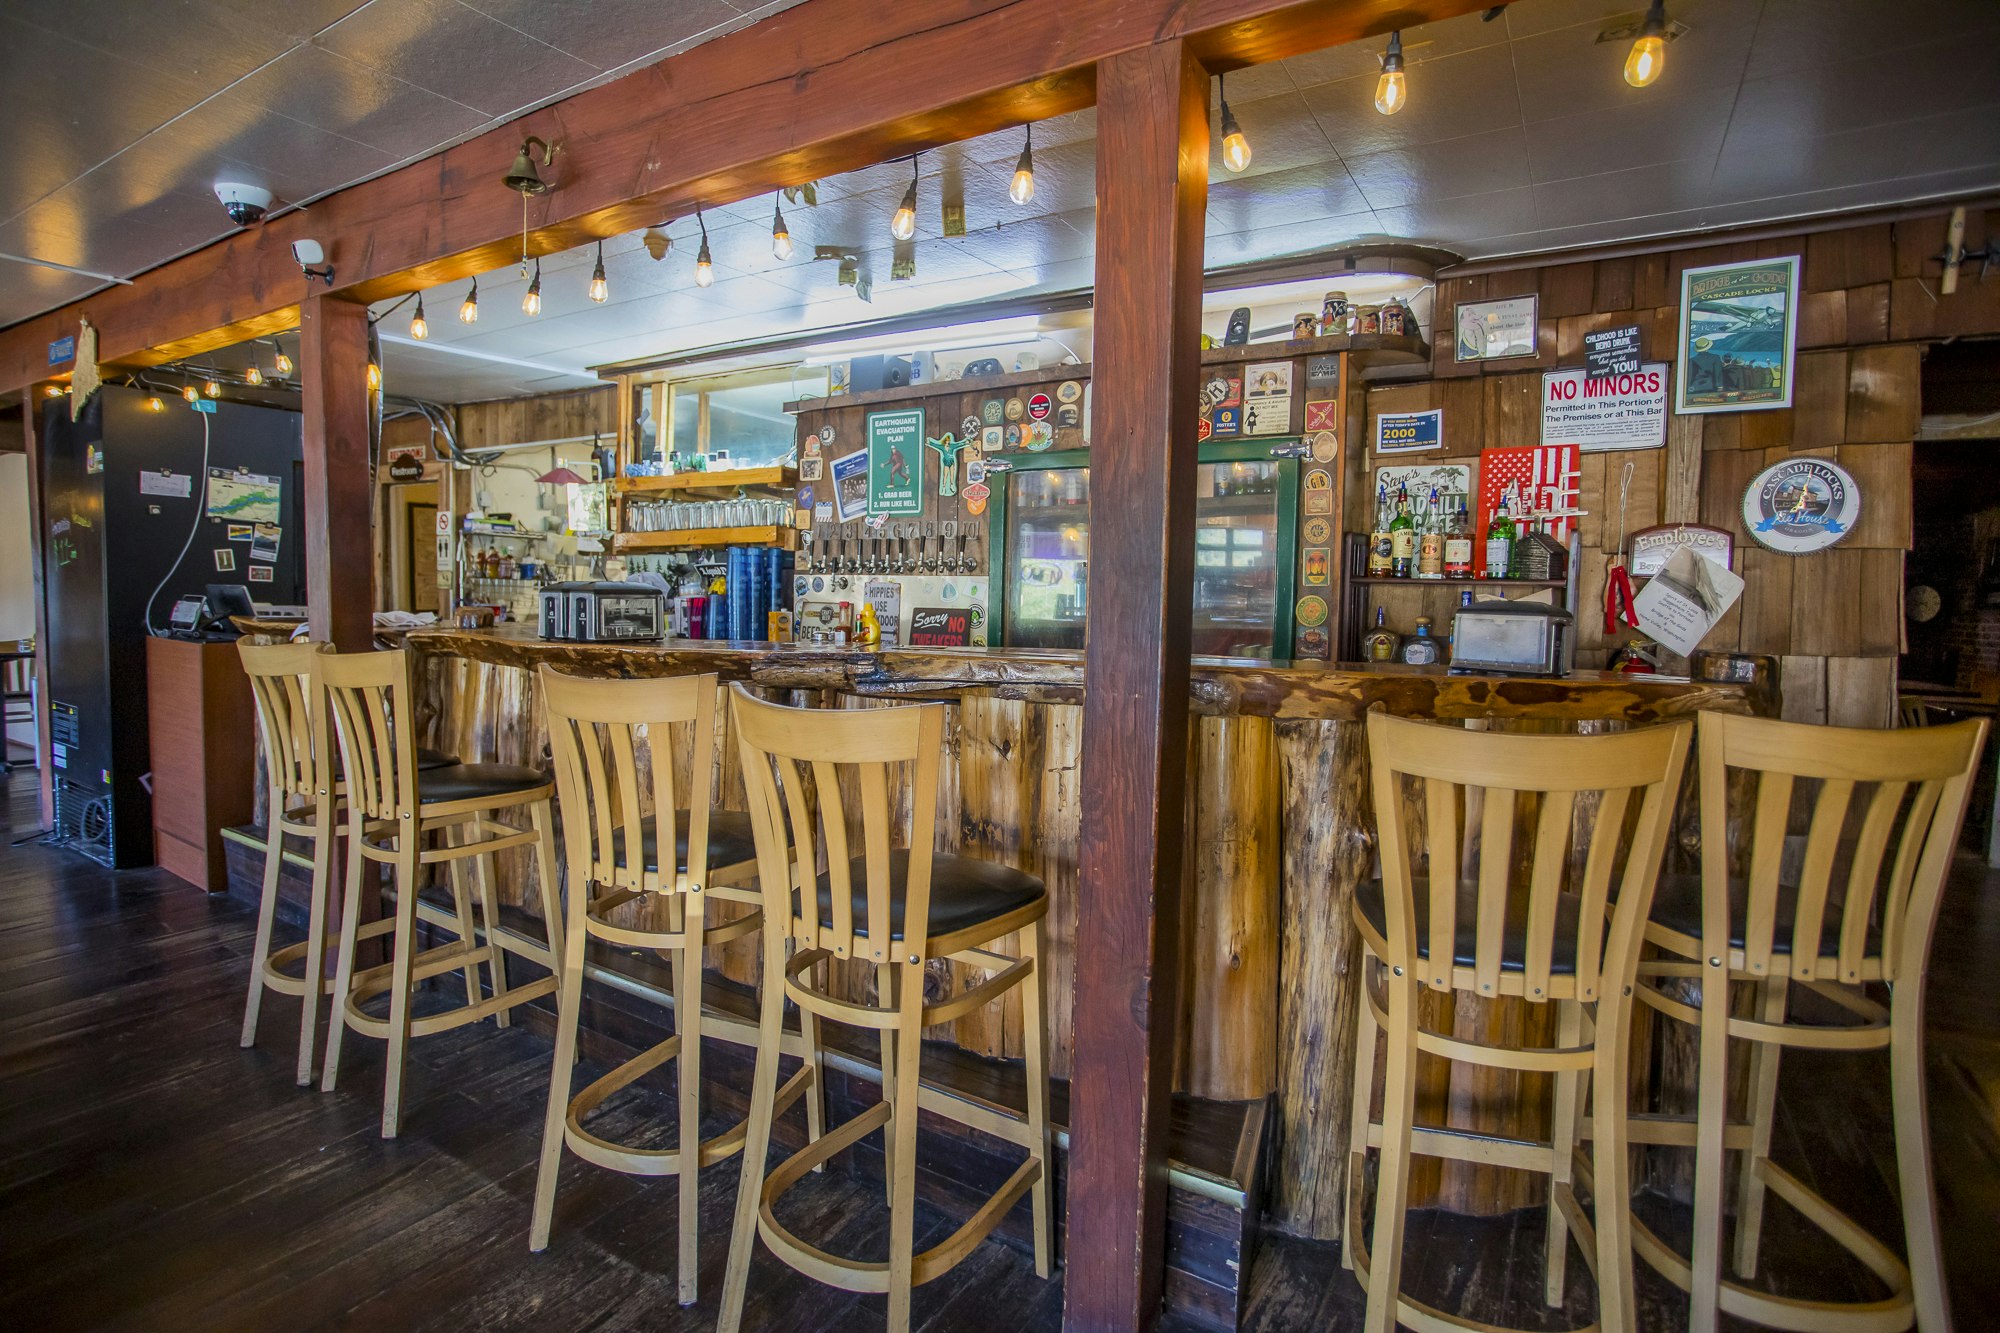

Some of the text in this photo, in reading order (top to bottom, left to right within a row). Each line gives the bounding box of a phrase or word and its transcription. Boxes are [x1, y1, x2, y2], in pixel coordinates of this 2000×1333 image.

[1692, 276, 1731, 296] BRIDGE
[1752, 273, 1786, 284] GODS
[1702, 286, 1777, 300] CASCADE LOCKS
[1586, 332, 1616, 344] CHILDHOOD
[1624, 327, 1638, 336] LIKE
[1596, 337, 1630, 350] BEING DRUNK
[1612, 360, 1638, 374] YOU!
[1550, 372, 1660, 401] NO MINORS
[1546, 402, 1586, 412] Permitted
[1598, 400, 1616, 408] This
[1618, 398, 1652, 408] Portion
[1654, 396, 1664, 404] of
[1563, 412, 1602, 422] Premises
[1626, 408, 1644, 416] This
[1647, 407, 1662, 415] Bar
[875, 418, 916, 427] EARTHQUAKE
[876, 426, 915, 435] EVACUATION
[1384, 428, 1416, 438] 2000
[390, 448, 424, 460] RESOMS
[1379, 468, 1420, 490] Steve's
[1762, 464, 1843, 500] CASCADE LOCKS
[1796, 510, 1829, 524] House
[829, 523, 838, 538] 2
[846, 523, 853, 538] 3
[864, 524, 872, 538] 4
[893, 523, 902, 538] 6
[908, 523, 916, 538] 7
[926, 522, 933, 538] 8
[944, 522, 953, 538] 9
[1636, 529, 1726, 551] Employee's
[869, 587, 894, 598] HIPPIES
[875, 601, 887, 612] USE
[876, 615, 898, 626] KDOOR
[914, 612, 948, 627] Sorry
[948, 617, 965, 632] NO
